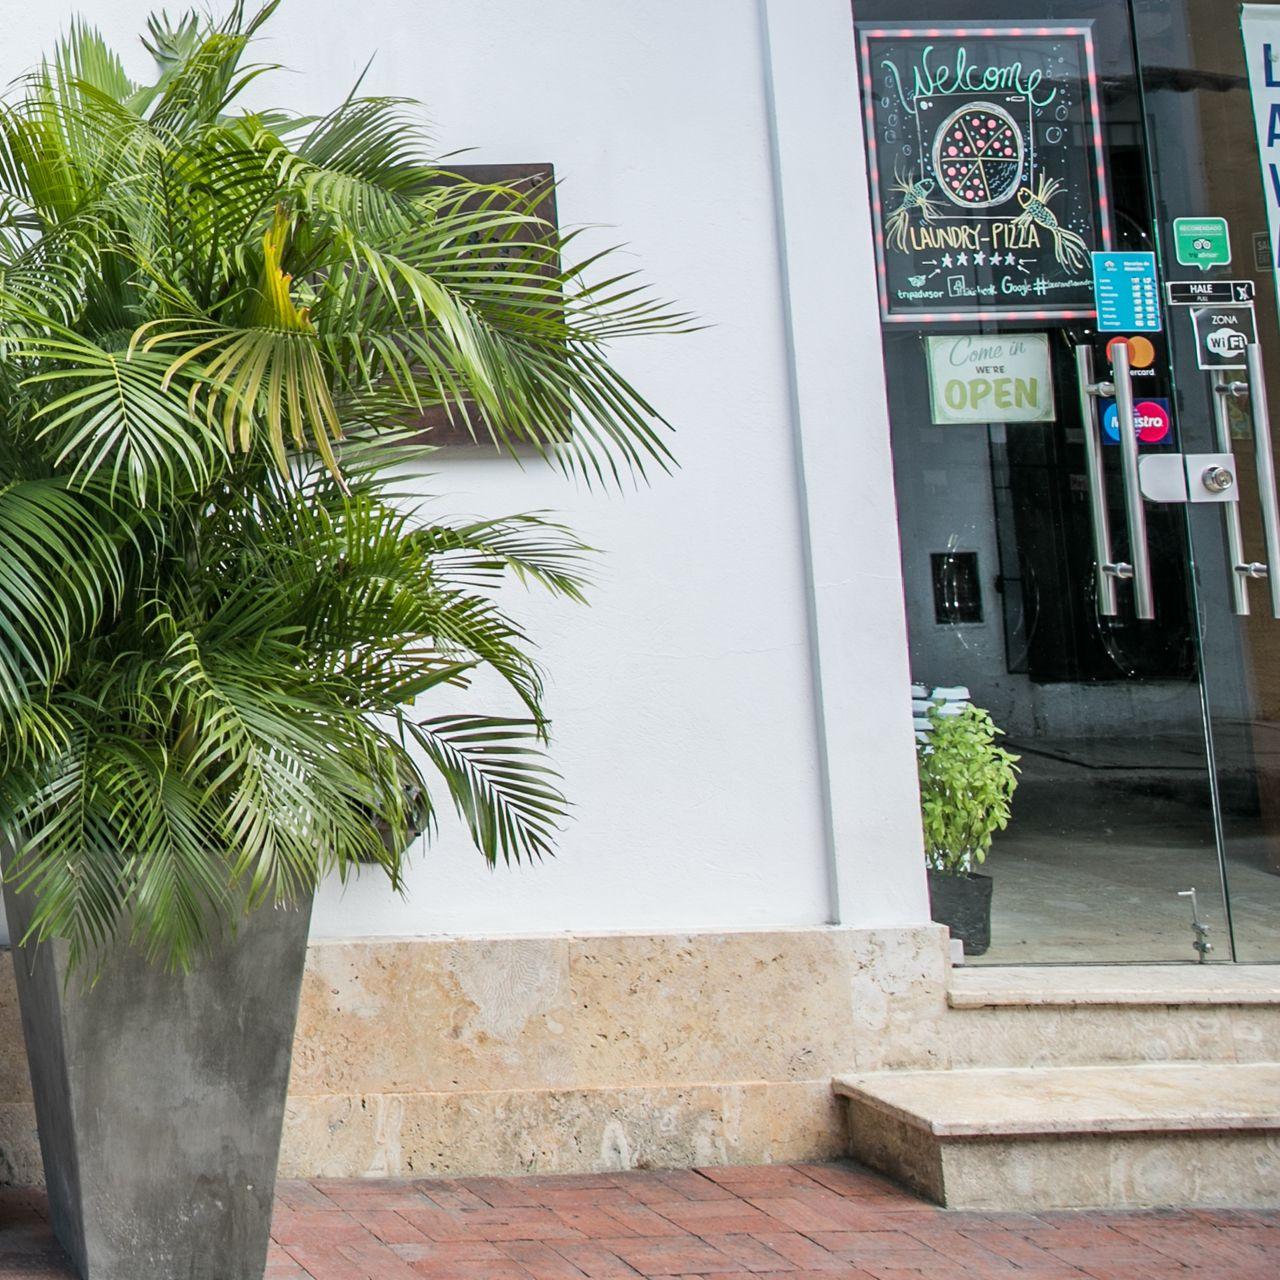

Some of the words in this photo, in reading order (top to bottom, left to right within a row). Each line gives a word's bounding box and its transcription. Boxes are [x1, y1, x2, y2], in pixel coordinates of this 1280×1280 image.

[881, 45, 1056, 114] Welcome
[1001, 276, 1032, 297] Google
[1189, 284, 1213, 294] HALE
[1211, 315, 1238, 325] ZONA
[949, 336, 1003, 367] Come
[1009, 341, 1026, 356] in
[975, 365, 1005, 374] WE'RE
[944, 377, 1038, 410] OPEN
[1111, 415, 1163, 428] Mstro
